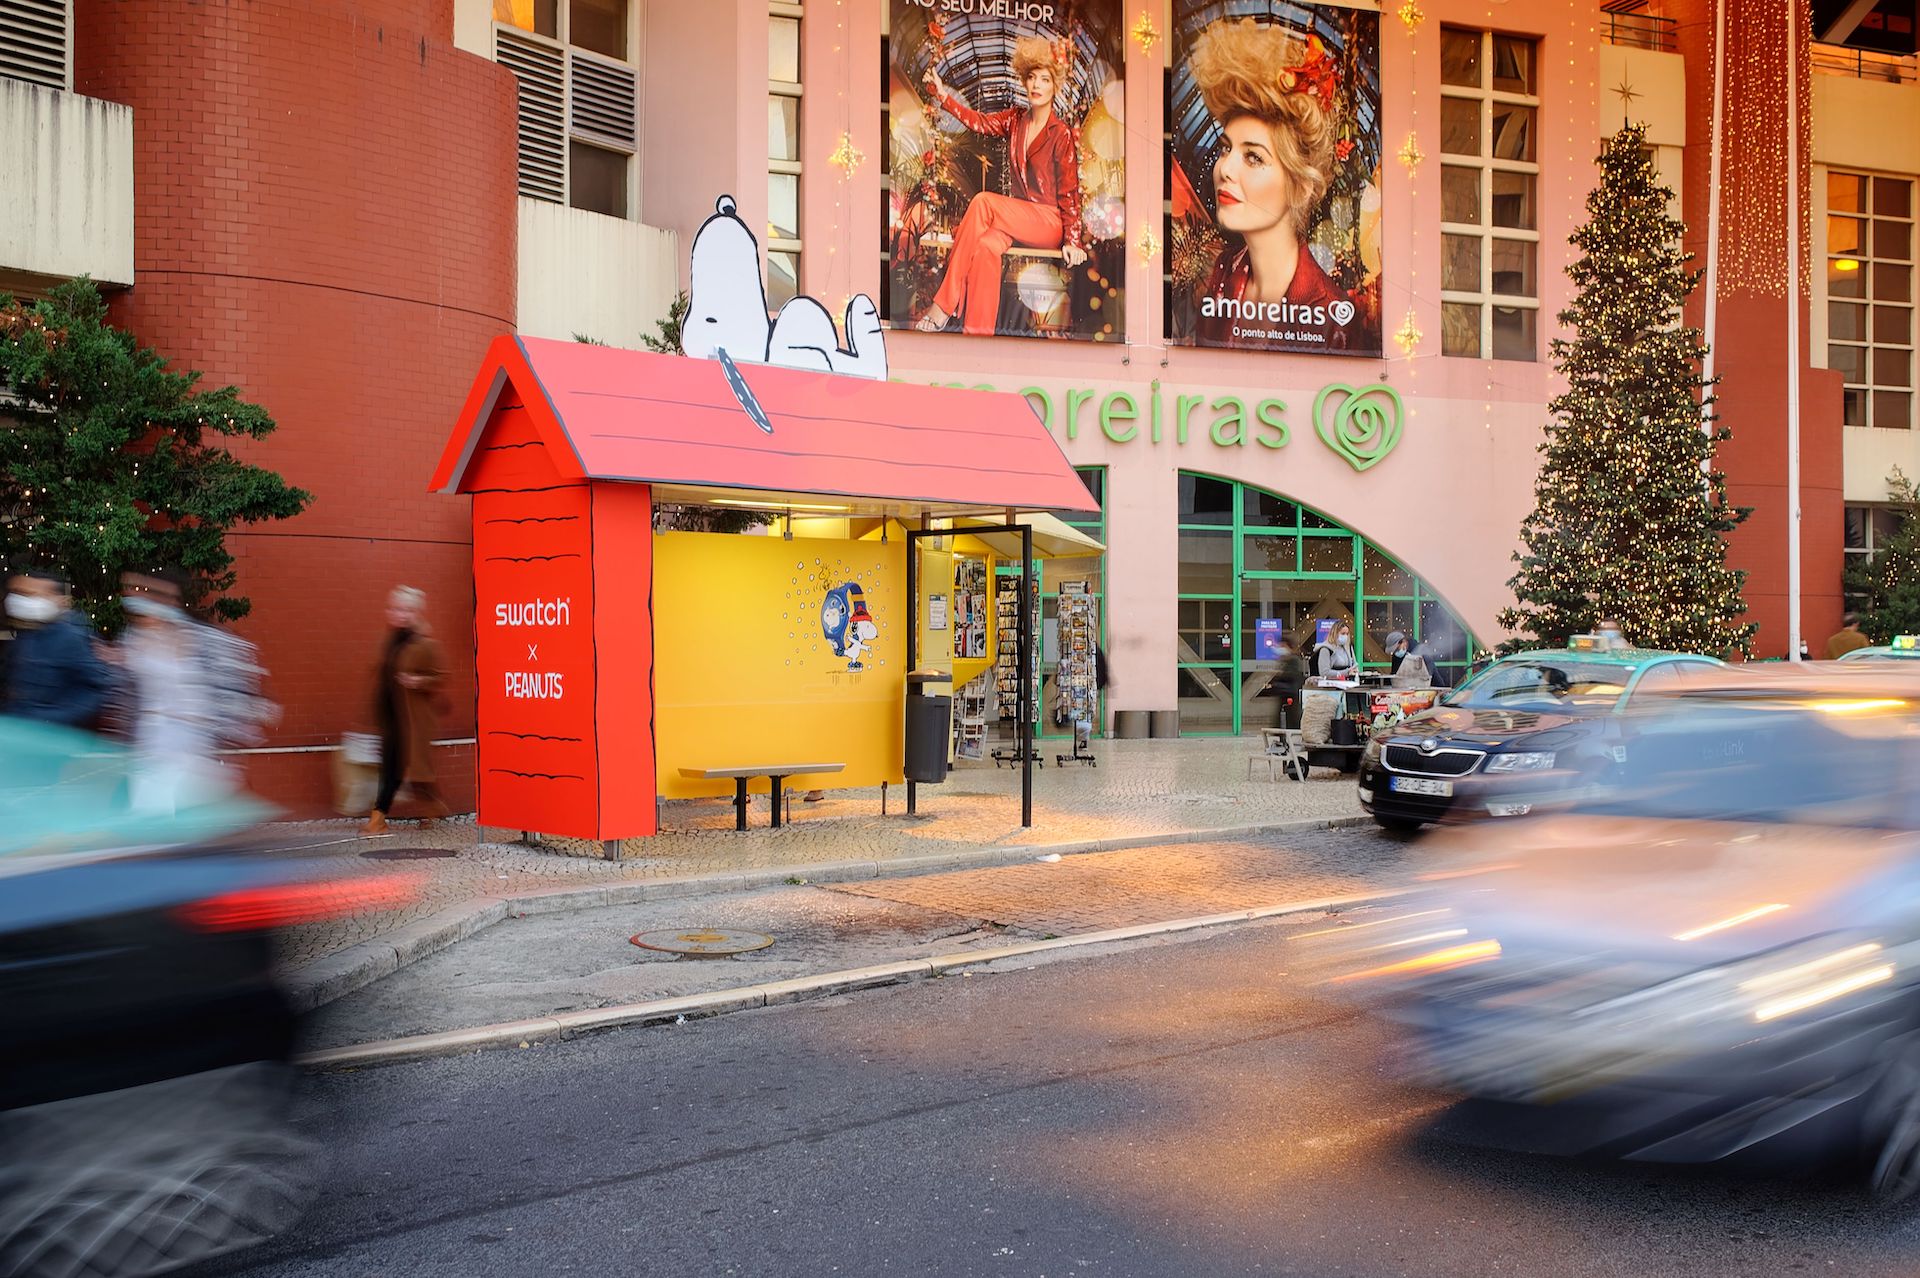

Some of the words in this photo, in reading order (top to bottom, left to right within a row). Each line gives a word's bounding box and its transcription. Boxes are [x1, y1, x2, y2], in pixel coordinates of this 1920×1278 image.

[979, 0, 1054, 23] MELHOR
[1201, 296, 1326, 326] amoreiras
[1232, 326, 1240, 336] O
[1241, 328, 1266, 339] ponto
[1267, 329, 1284, 340] alto
[1284, 330, 1296, 341] de
[1296, 331, 1326, 343] Lisboa.
[495, 597, 570, 626] swatch
[504, 671, 564, 700] PEANUTS
